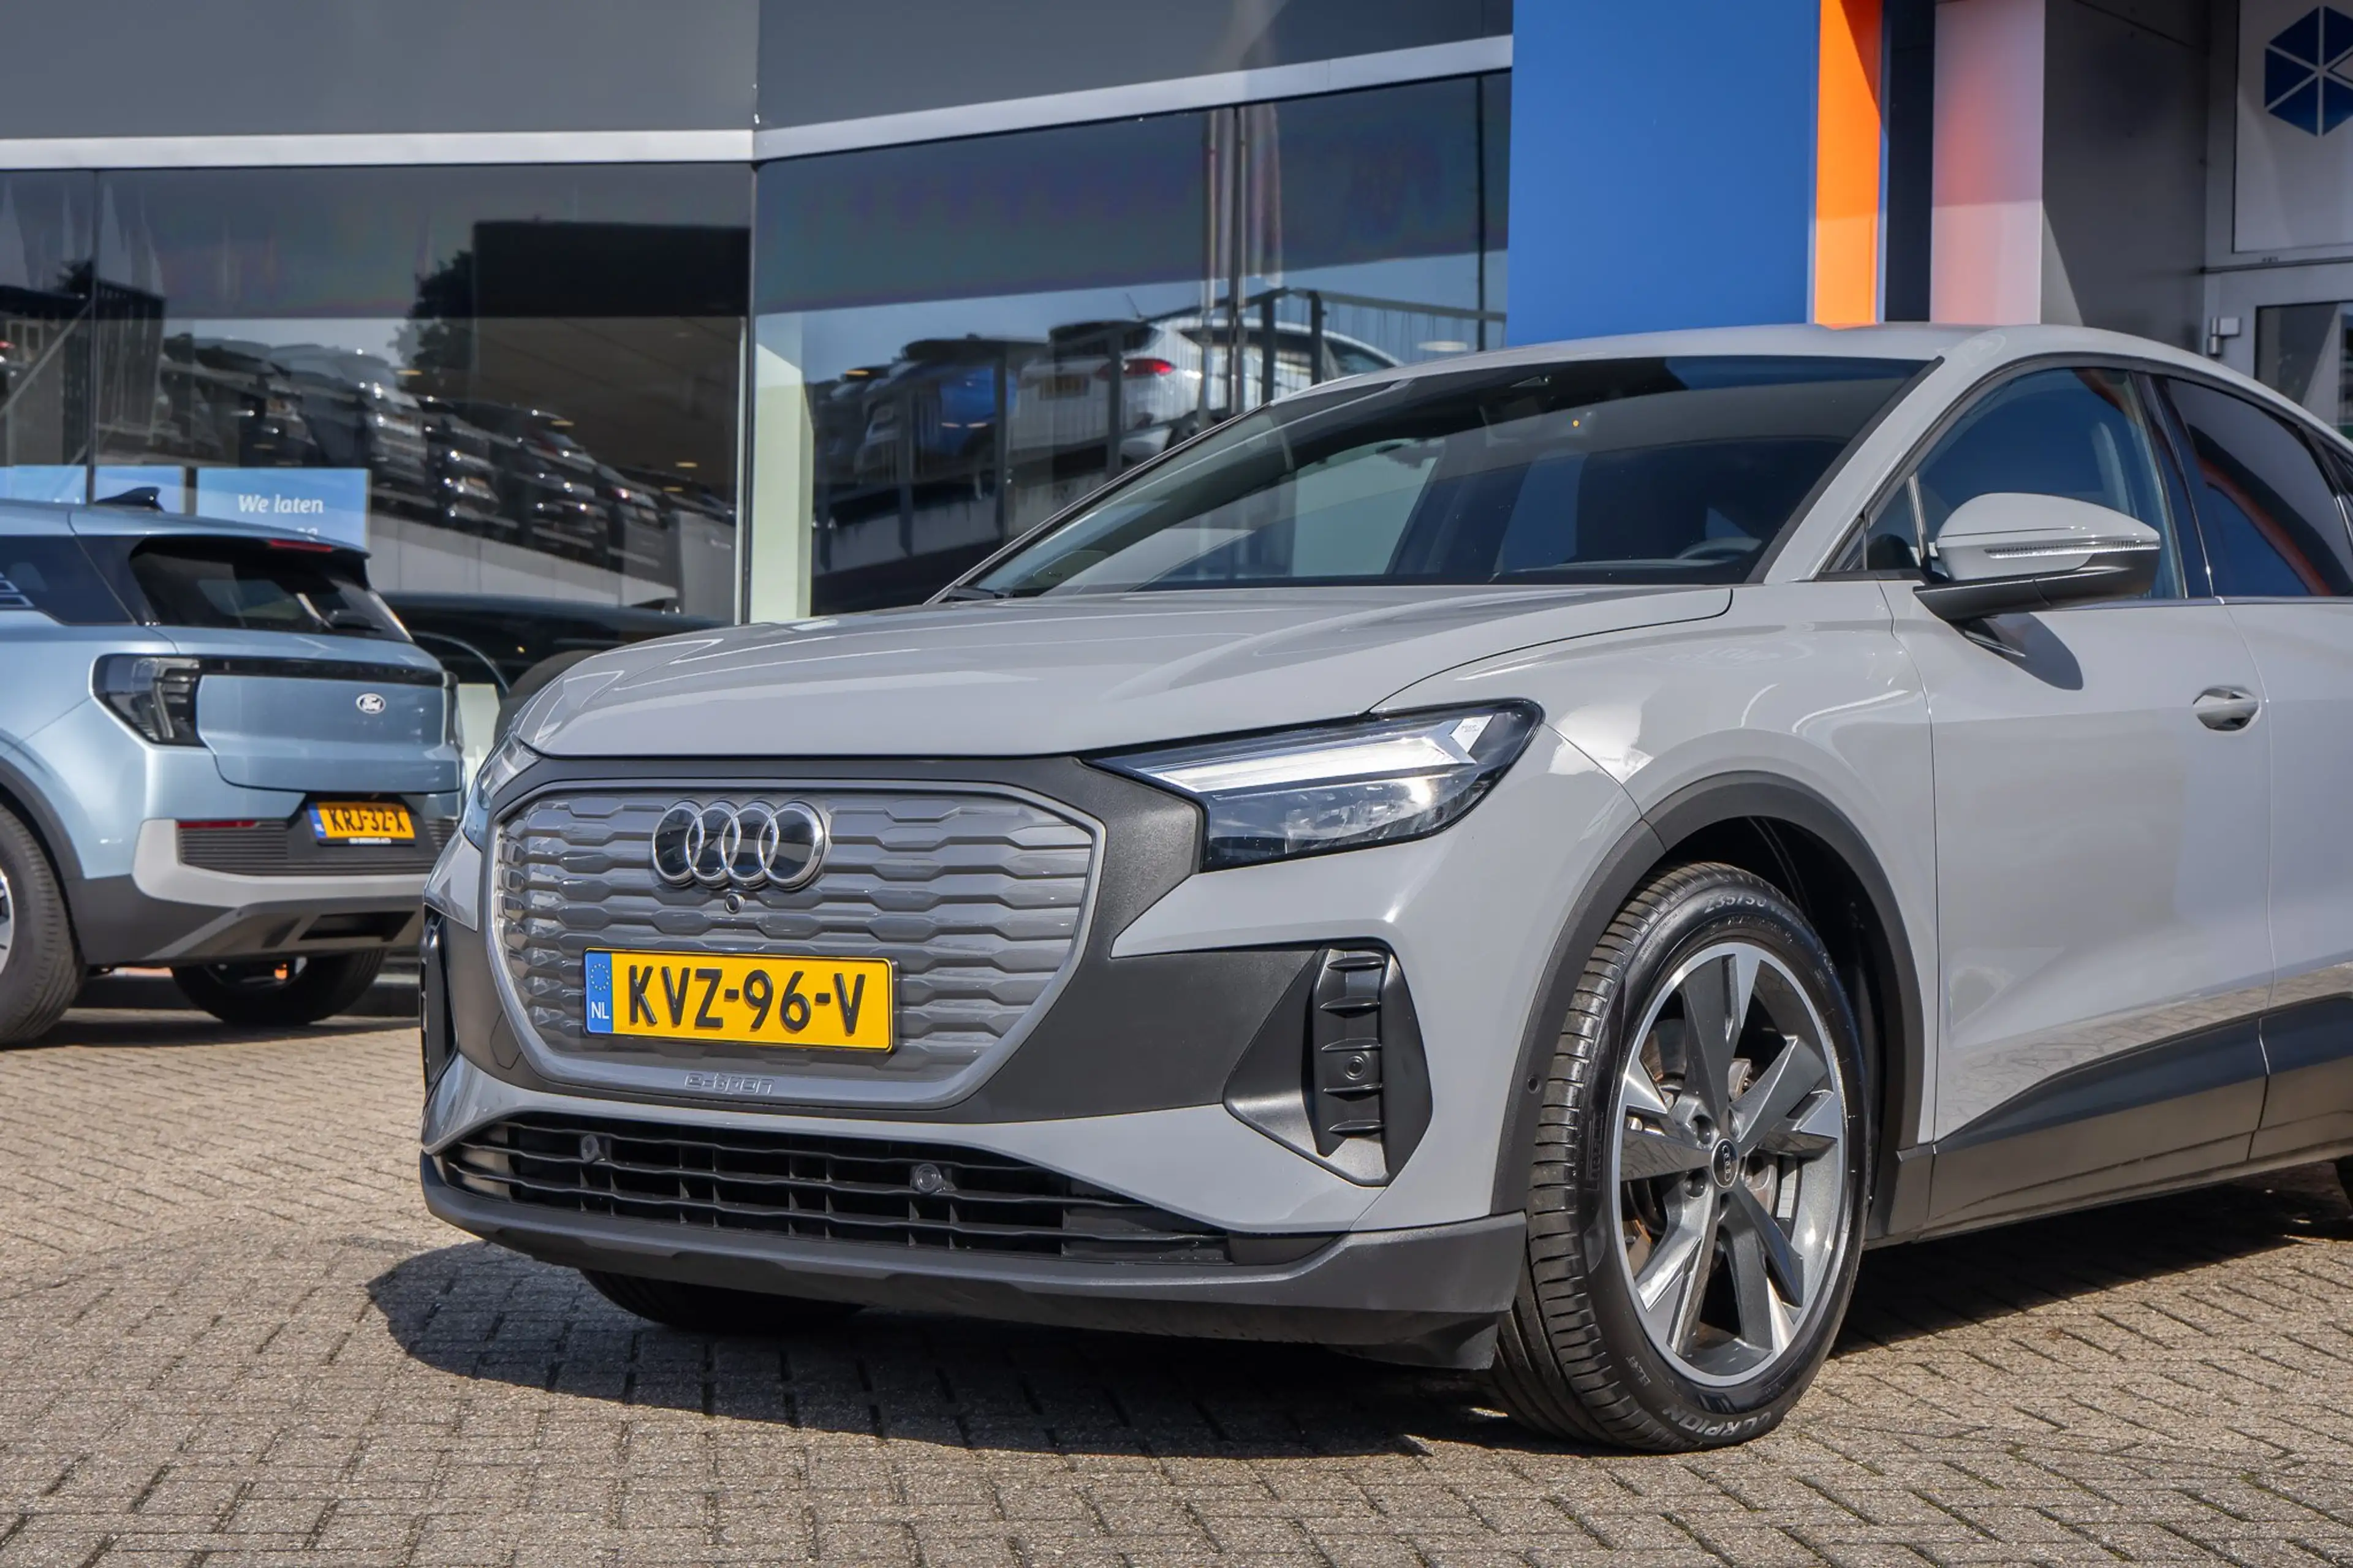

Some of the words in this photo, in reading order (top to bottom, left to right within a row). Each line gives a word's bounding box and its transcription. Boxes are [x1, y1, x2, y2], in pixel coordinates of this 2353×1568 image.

[238, 494, 268, 513] We
[274, 494, 324, 513] laten
[327, 806, 406, 832] KRJ-32-X
[591, 1001, 610, 1020] NL
[629, 964, 866, 1036] KVZ-96-V
[684, 1072, 775, 1095] e-tron
